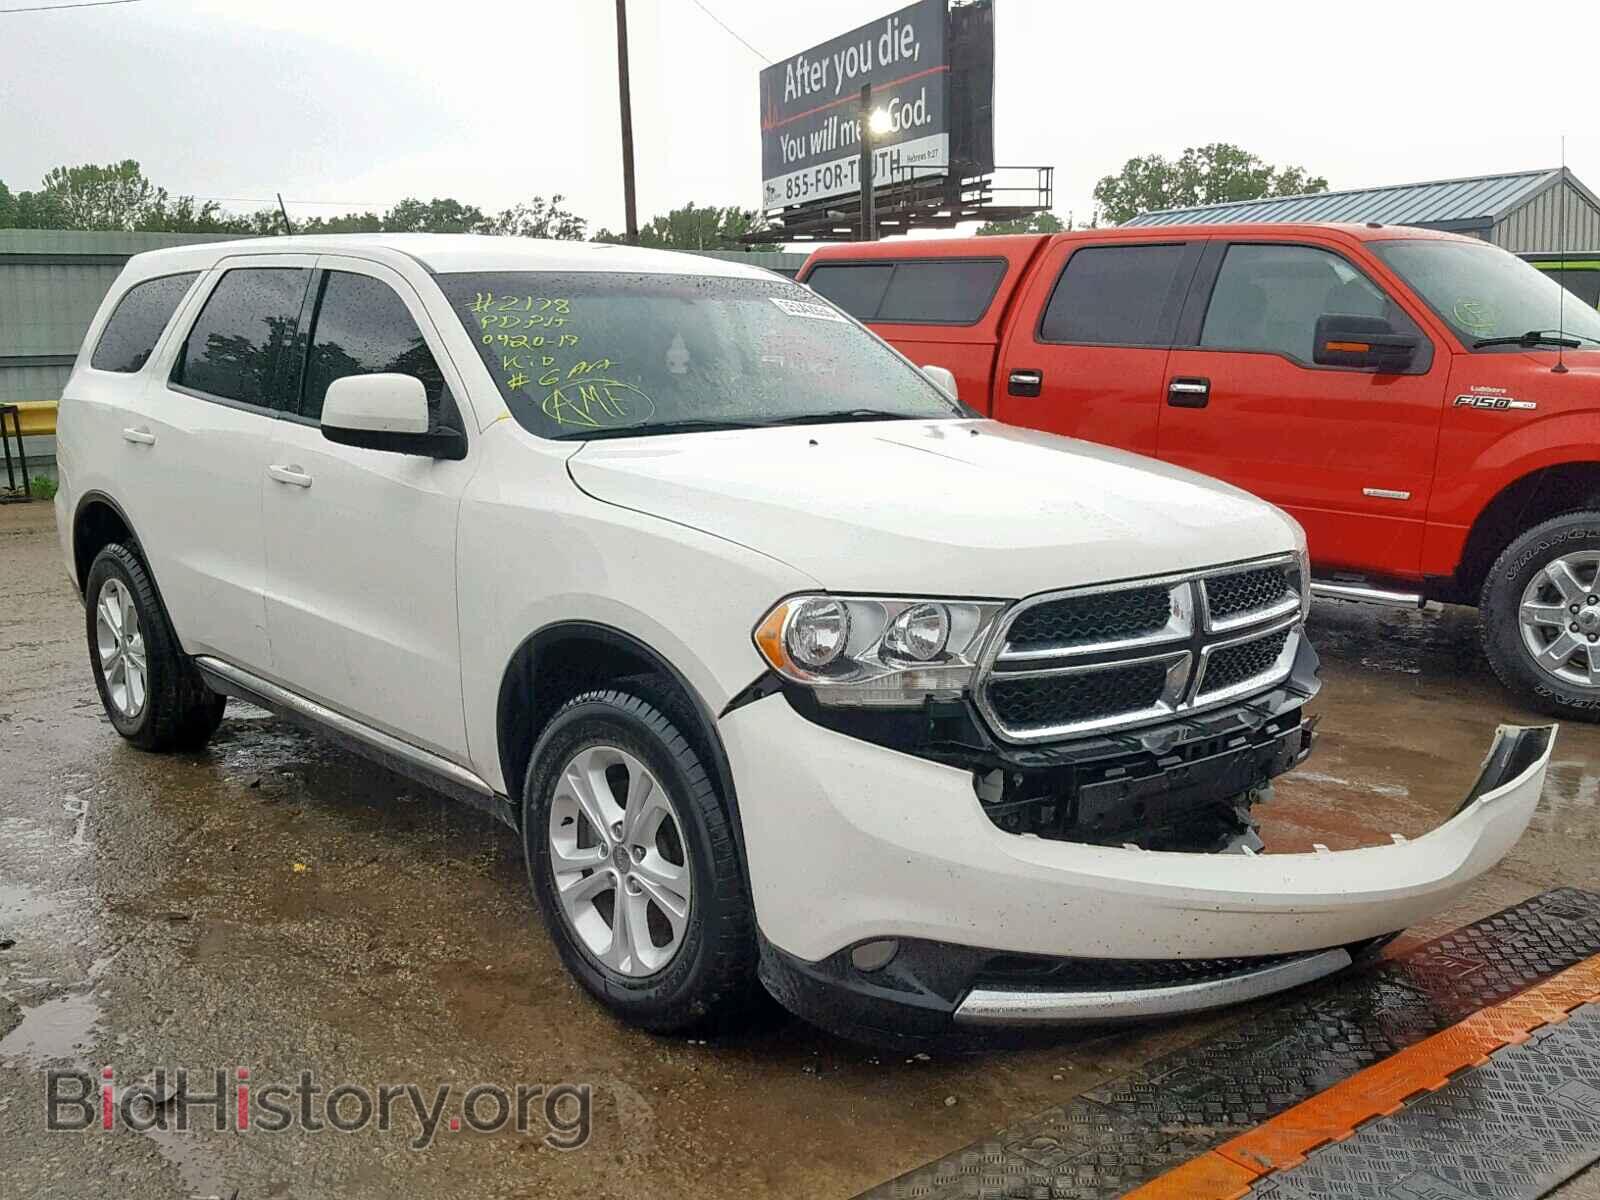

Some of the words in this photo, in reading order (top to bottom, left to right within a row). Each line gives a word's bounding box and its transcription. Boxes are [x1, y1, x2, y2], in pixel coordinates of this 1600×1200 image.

[784, 55, 829, 104] After
[833, 39, 872, 95] you
[878, 17, 920, 66] die,
[780, 133, 805, 164] You
[810, 115, 838, 156] will
[886, 86, 932, 133] God.
[785, 148, 901, 200] 855-FOR-TUTH
